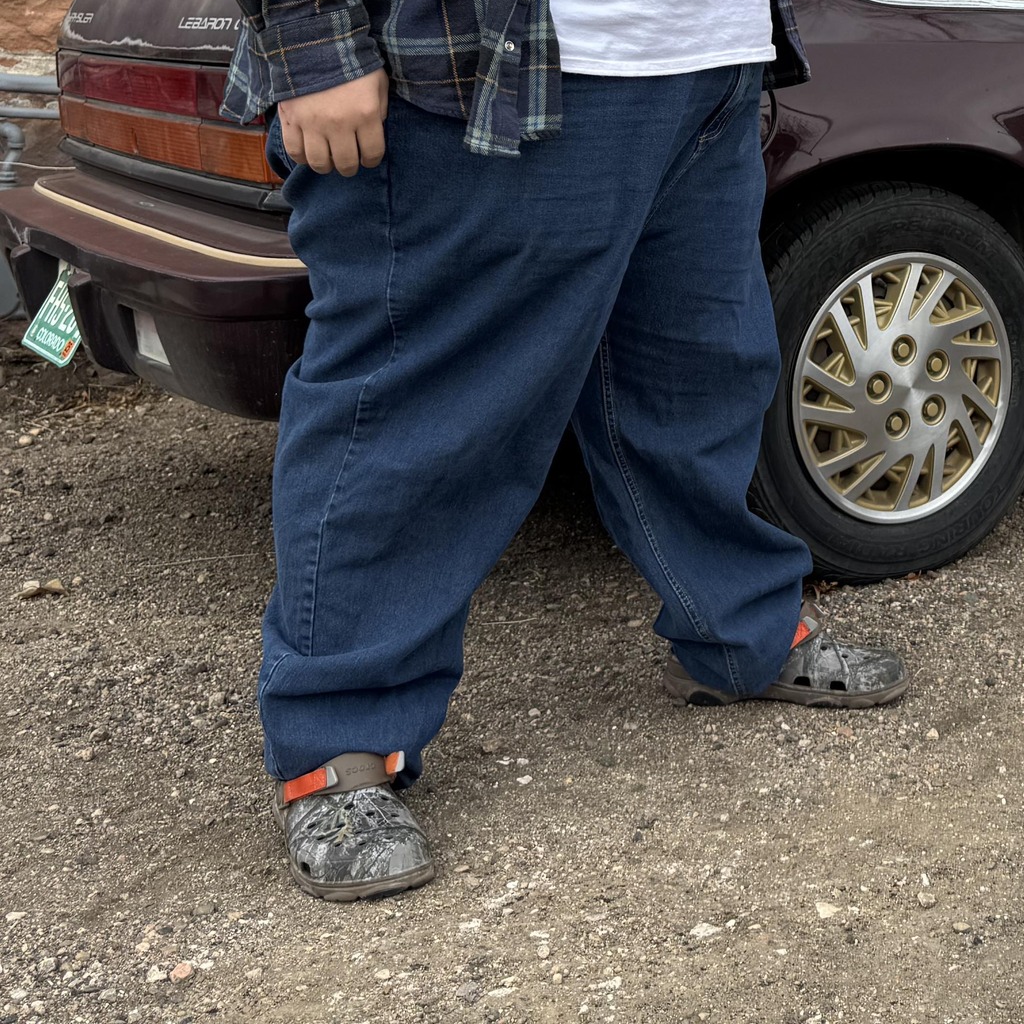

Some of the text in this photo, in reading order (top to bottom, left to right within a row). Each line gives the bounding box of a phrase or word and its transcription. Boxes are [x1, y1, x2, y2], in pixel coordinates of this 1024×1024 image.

[178, 16, 233, 30] LEBARON
[35, 326, 66, 352] COLORADO
[916, 482, 1007, 556] TOURING
